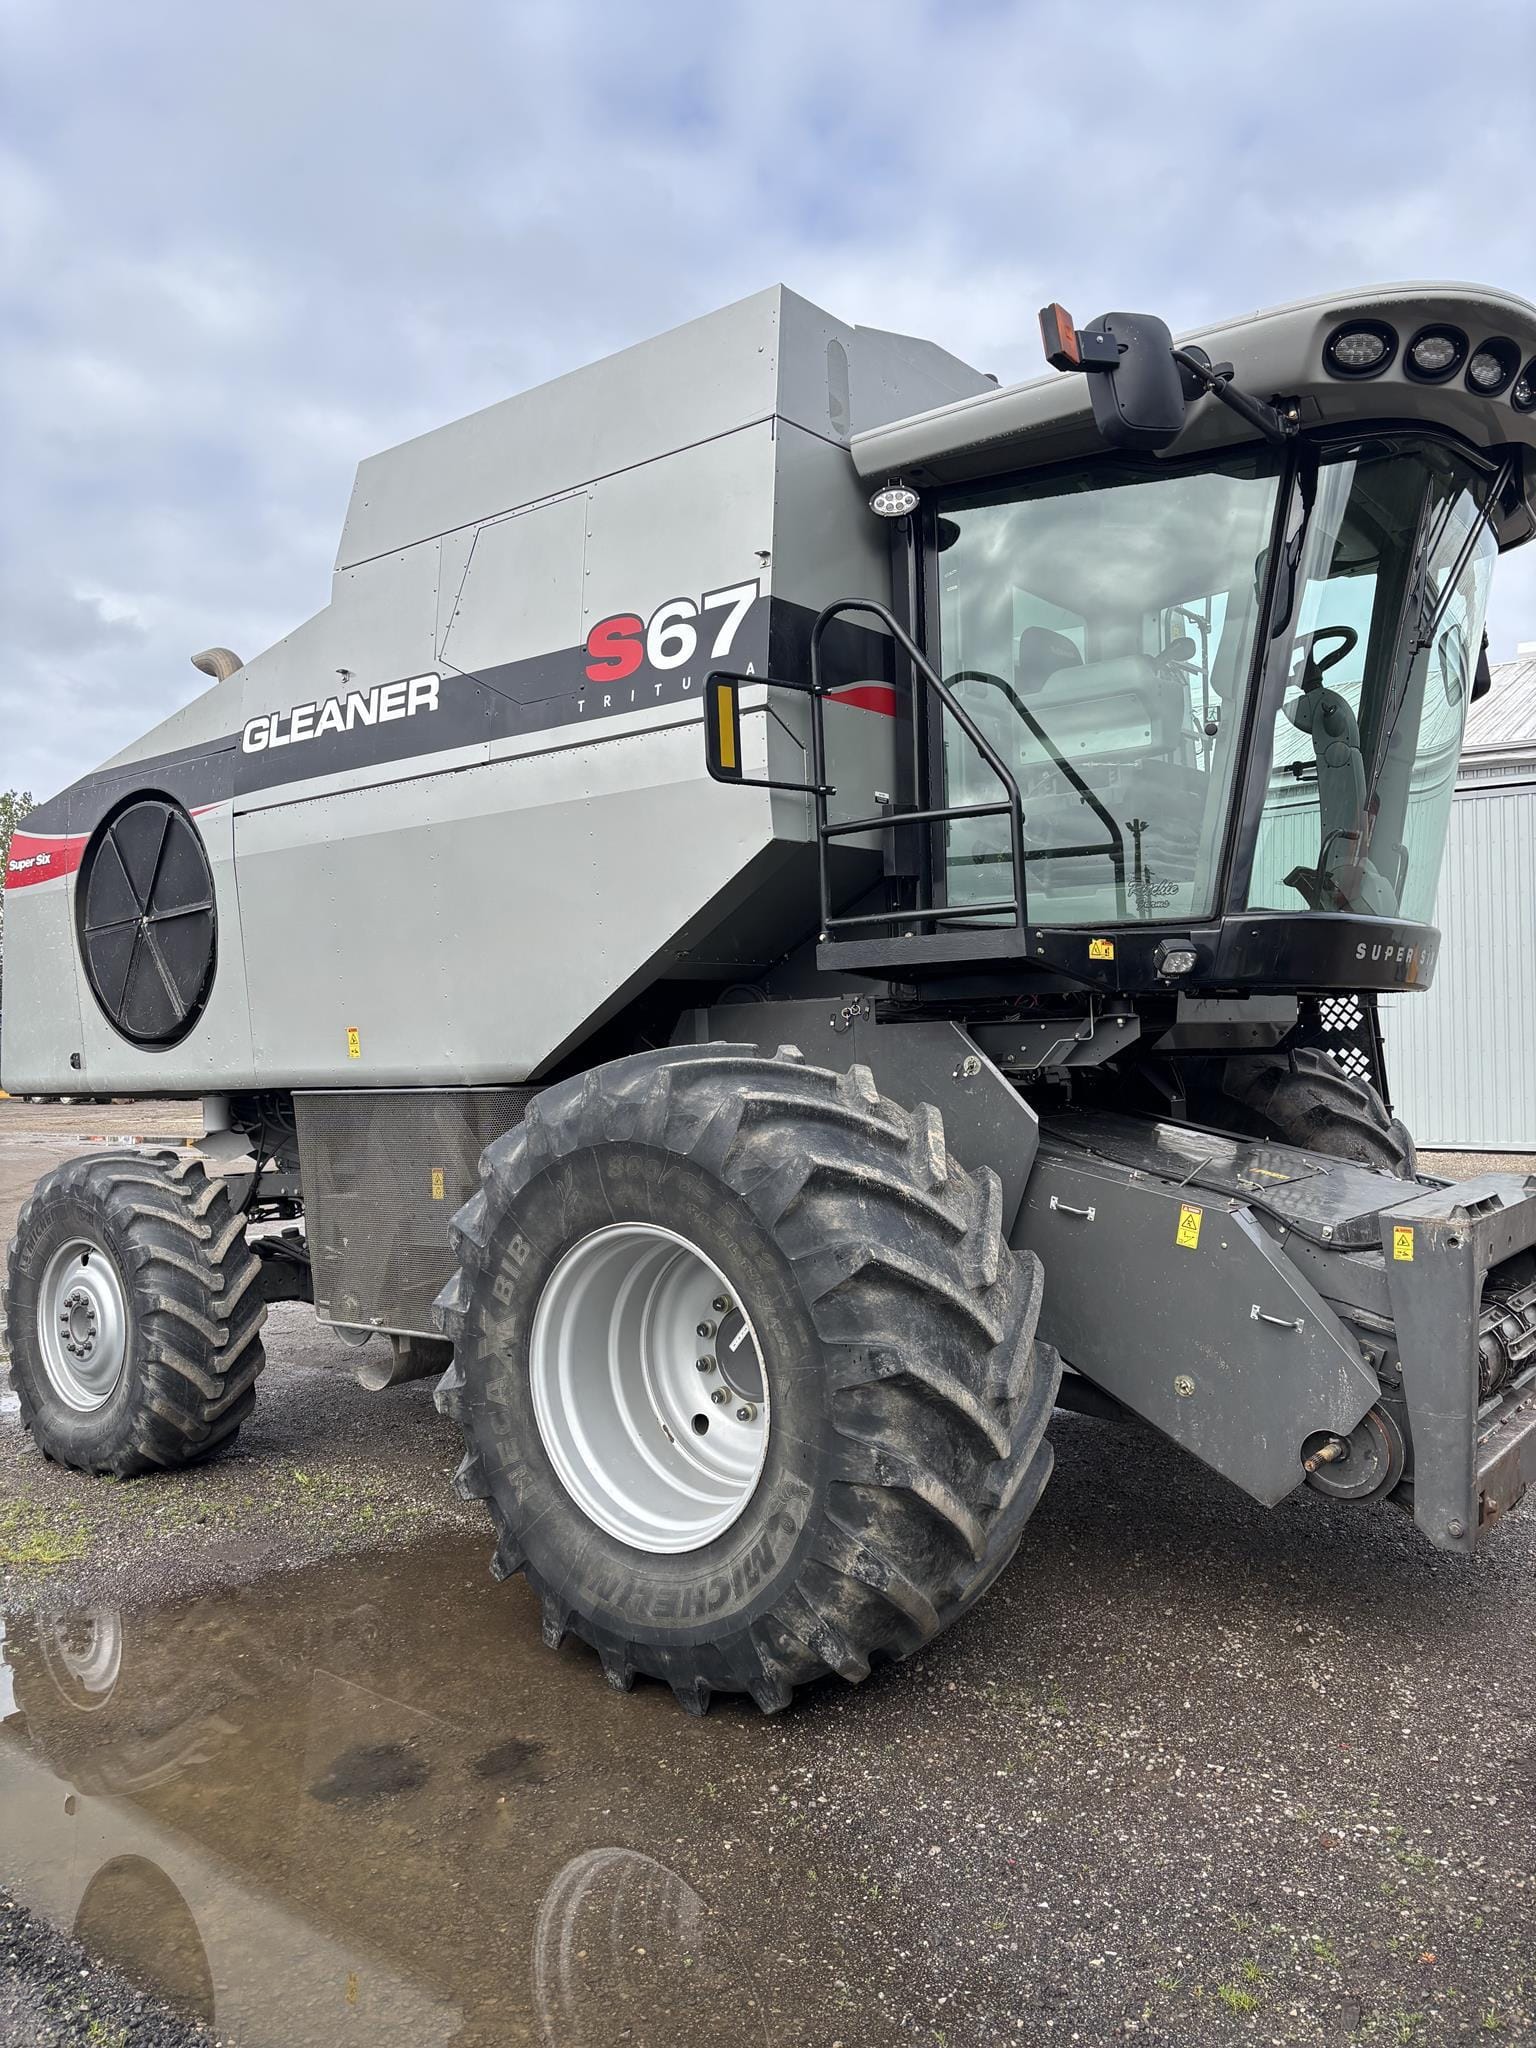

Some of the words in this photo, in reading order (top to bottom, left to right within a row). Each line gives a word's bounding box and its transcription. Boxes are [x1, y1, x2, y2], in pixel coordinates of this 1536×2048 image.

[586, 577, 760, 682] S67
[242, 672, 441, 754] GLEANER
[577, 661, 755, 713] TRITUA
[9, 858, 36, 872] Super
[36, 852, 51, 866] Six
[1355, 942, 1414, 963] SUPER
